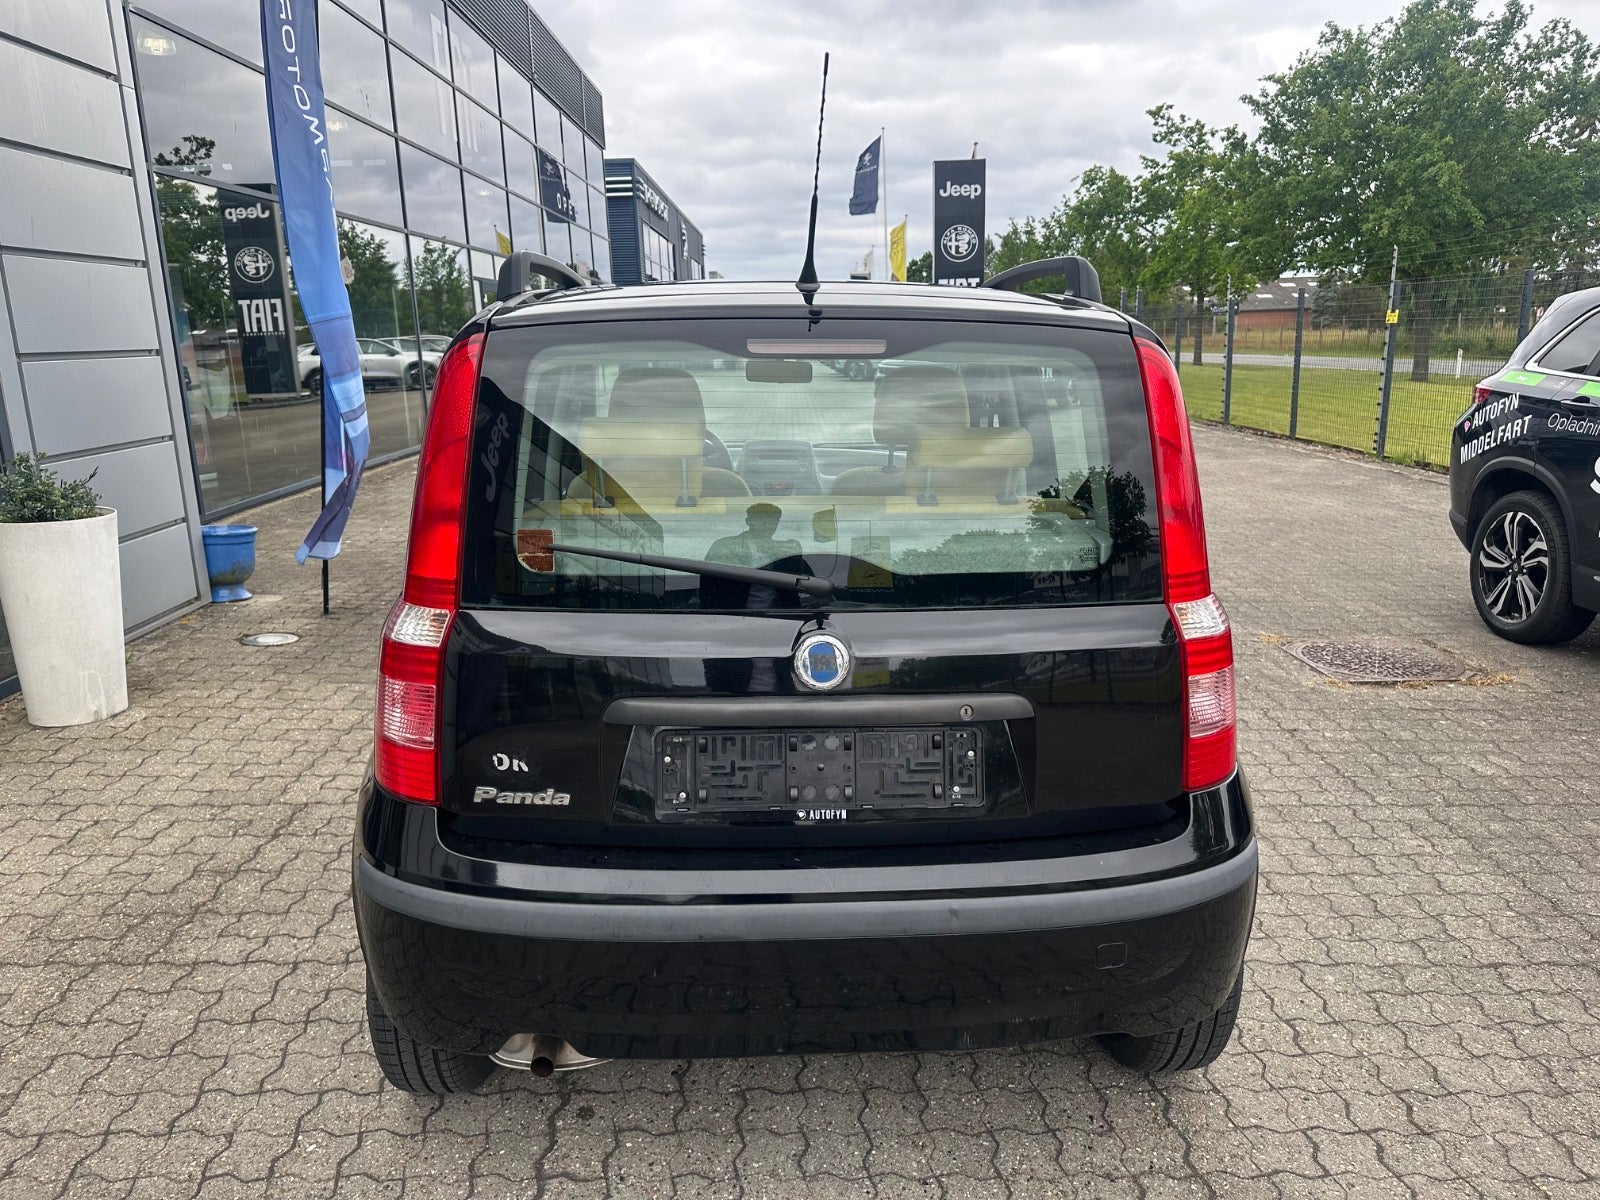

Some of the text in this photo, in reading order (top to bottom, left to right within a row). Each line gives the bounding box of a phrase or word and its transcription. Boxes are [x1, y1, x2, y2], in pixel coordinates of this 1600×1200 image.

[939, 181, 982, 199] Jeep
[1472, 391, 1521, 430] AUTOFYN
[1460, 414, 1533, 465] MIDDELFART
[473, 786, 571, 806] Panda
[809, 809, 847, 820] AUTOFYN
